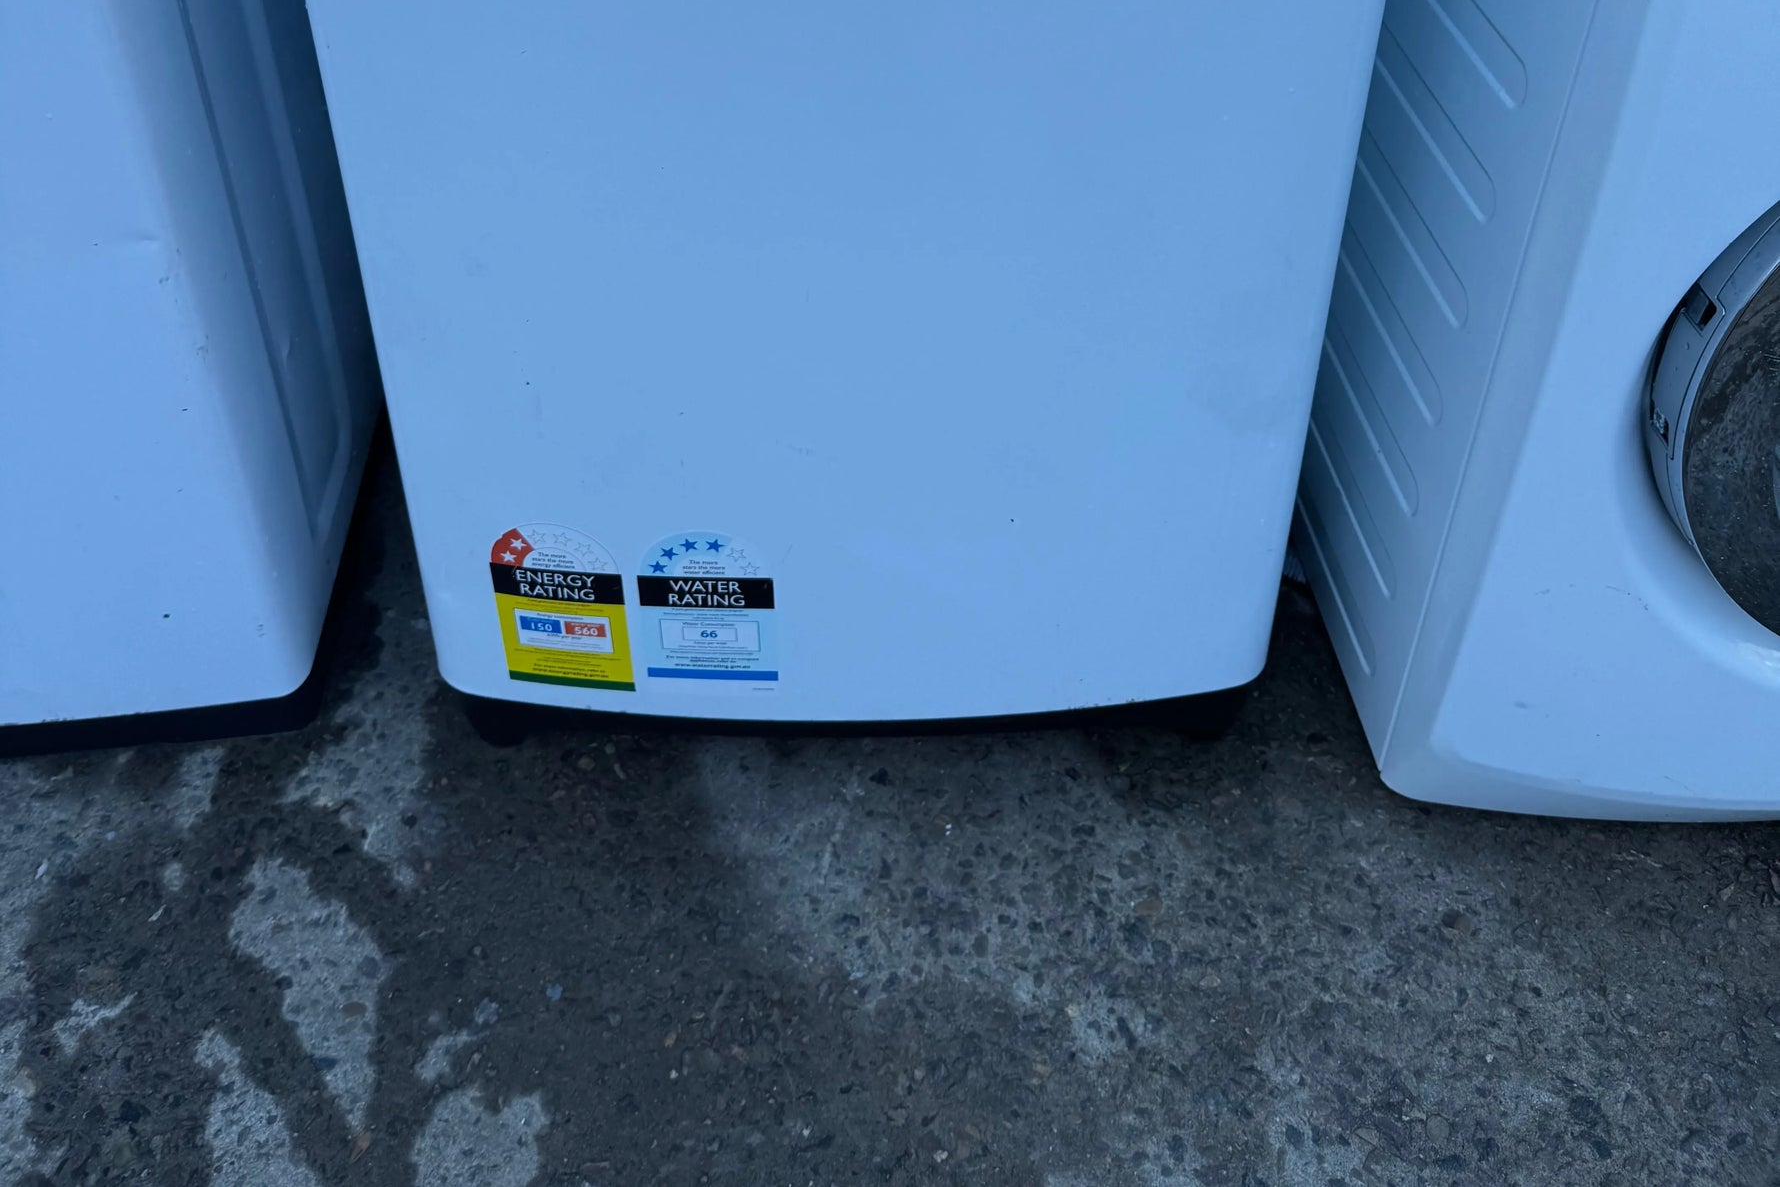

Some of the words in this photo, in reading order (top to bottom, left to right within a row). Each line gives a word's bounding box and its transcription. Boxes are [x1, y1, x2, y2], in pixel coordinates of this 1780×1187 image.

[515, 569, 595, 588] ENERGY
[519, 582, 595, 601] RATING
[669, 580, 742, 593] WATER
[668, 593, 746, 606] RATING
[530, 622, 553, 632] 150
[574, 626, 599, 636] 560
[700, 629, 718, 638] 66
